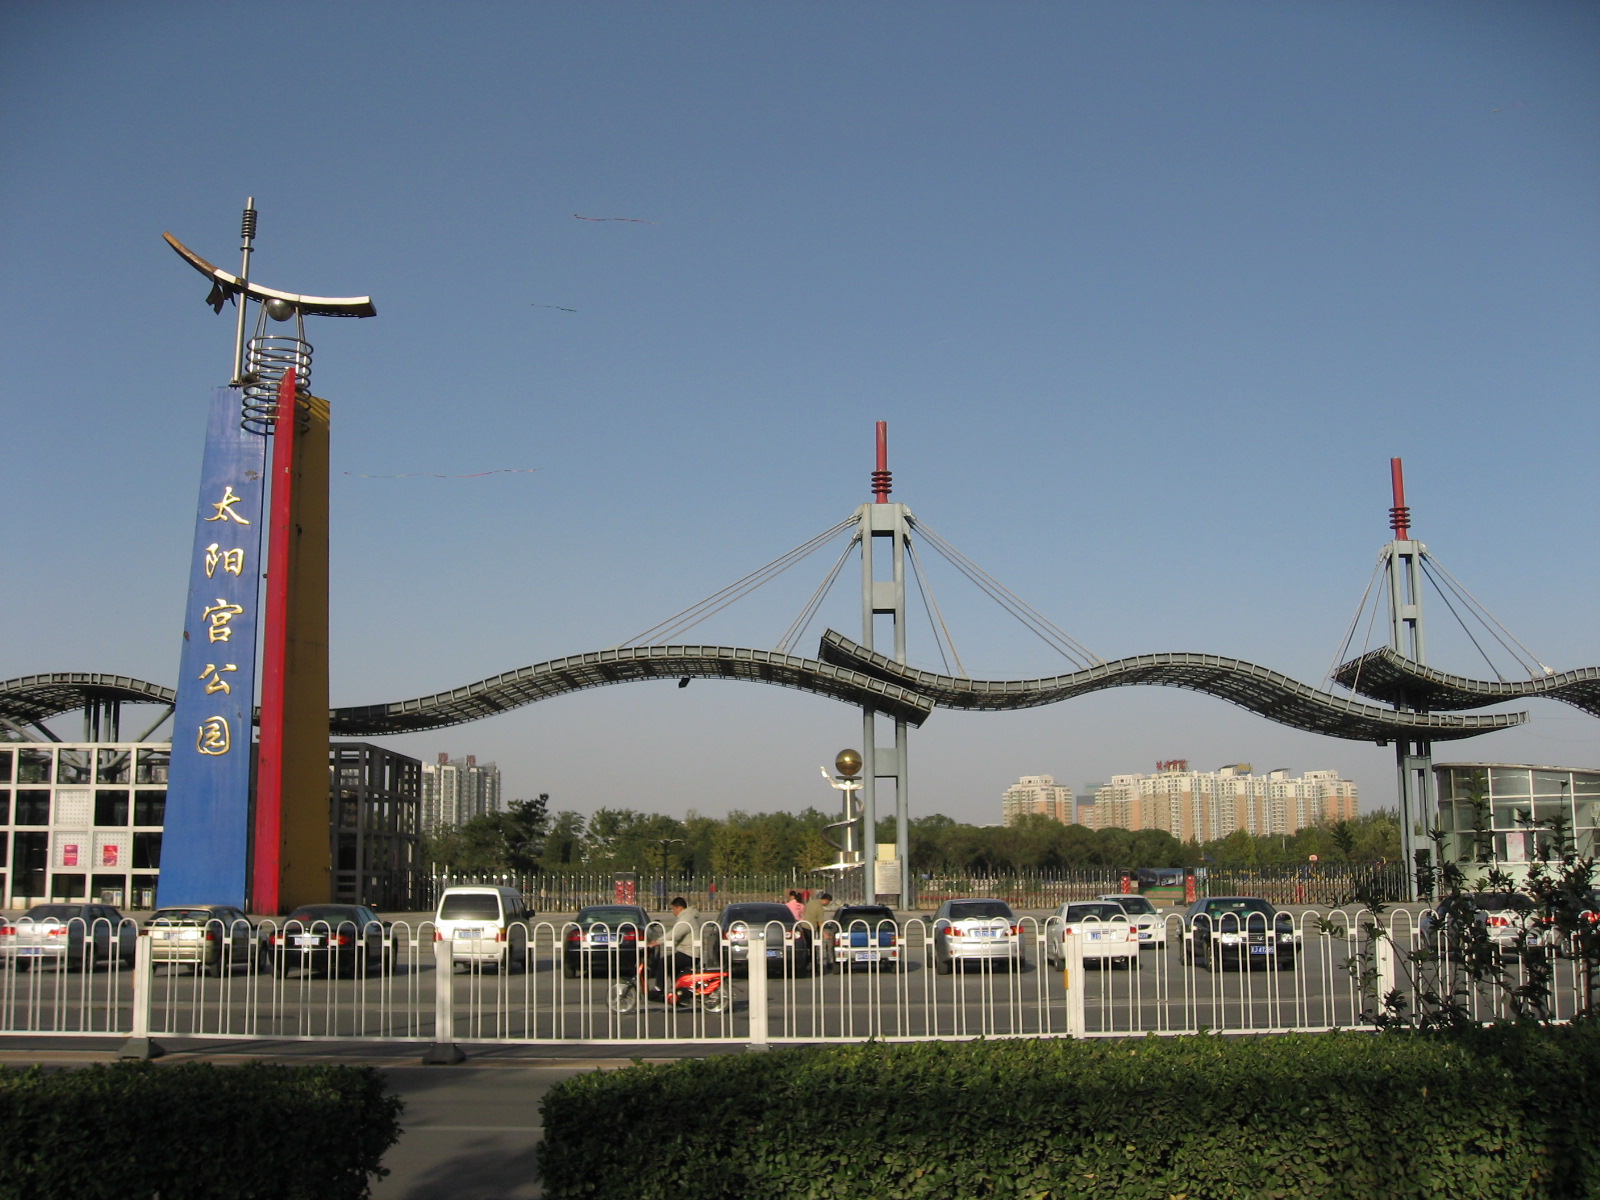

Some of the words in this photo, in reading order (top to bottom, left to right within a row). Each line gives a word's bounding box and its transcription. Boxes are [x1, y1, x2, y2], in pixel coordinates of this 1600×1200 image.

[196, 486, 250, 756] 太阳宫公园
